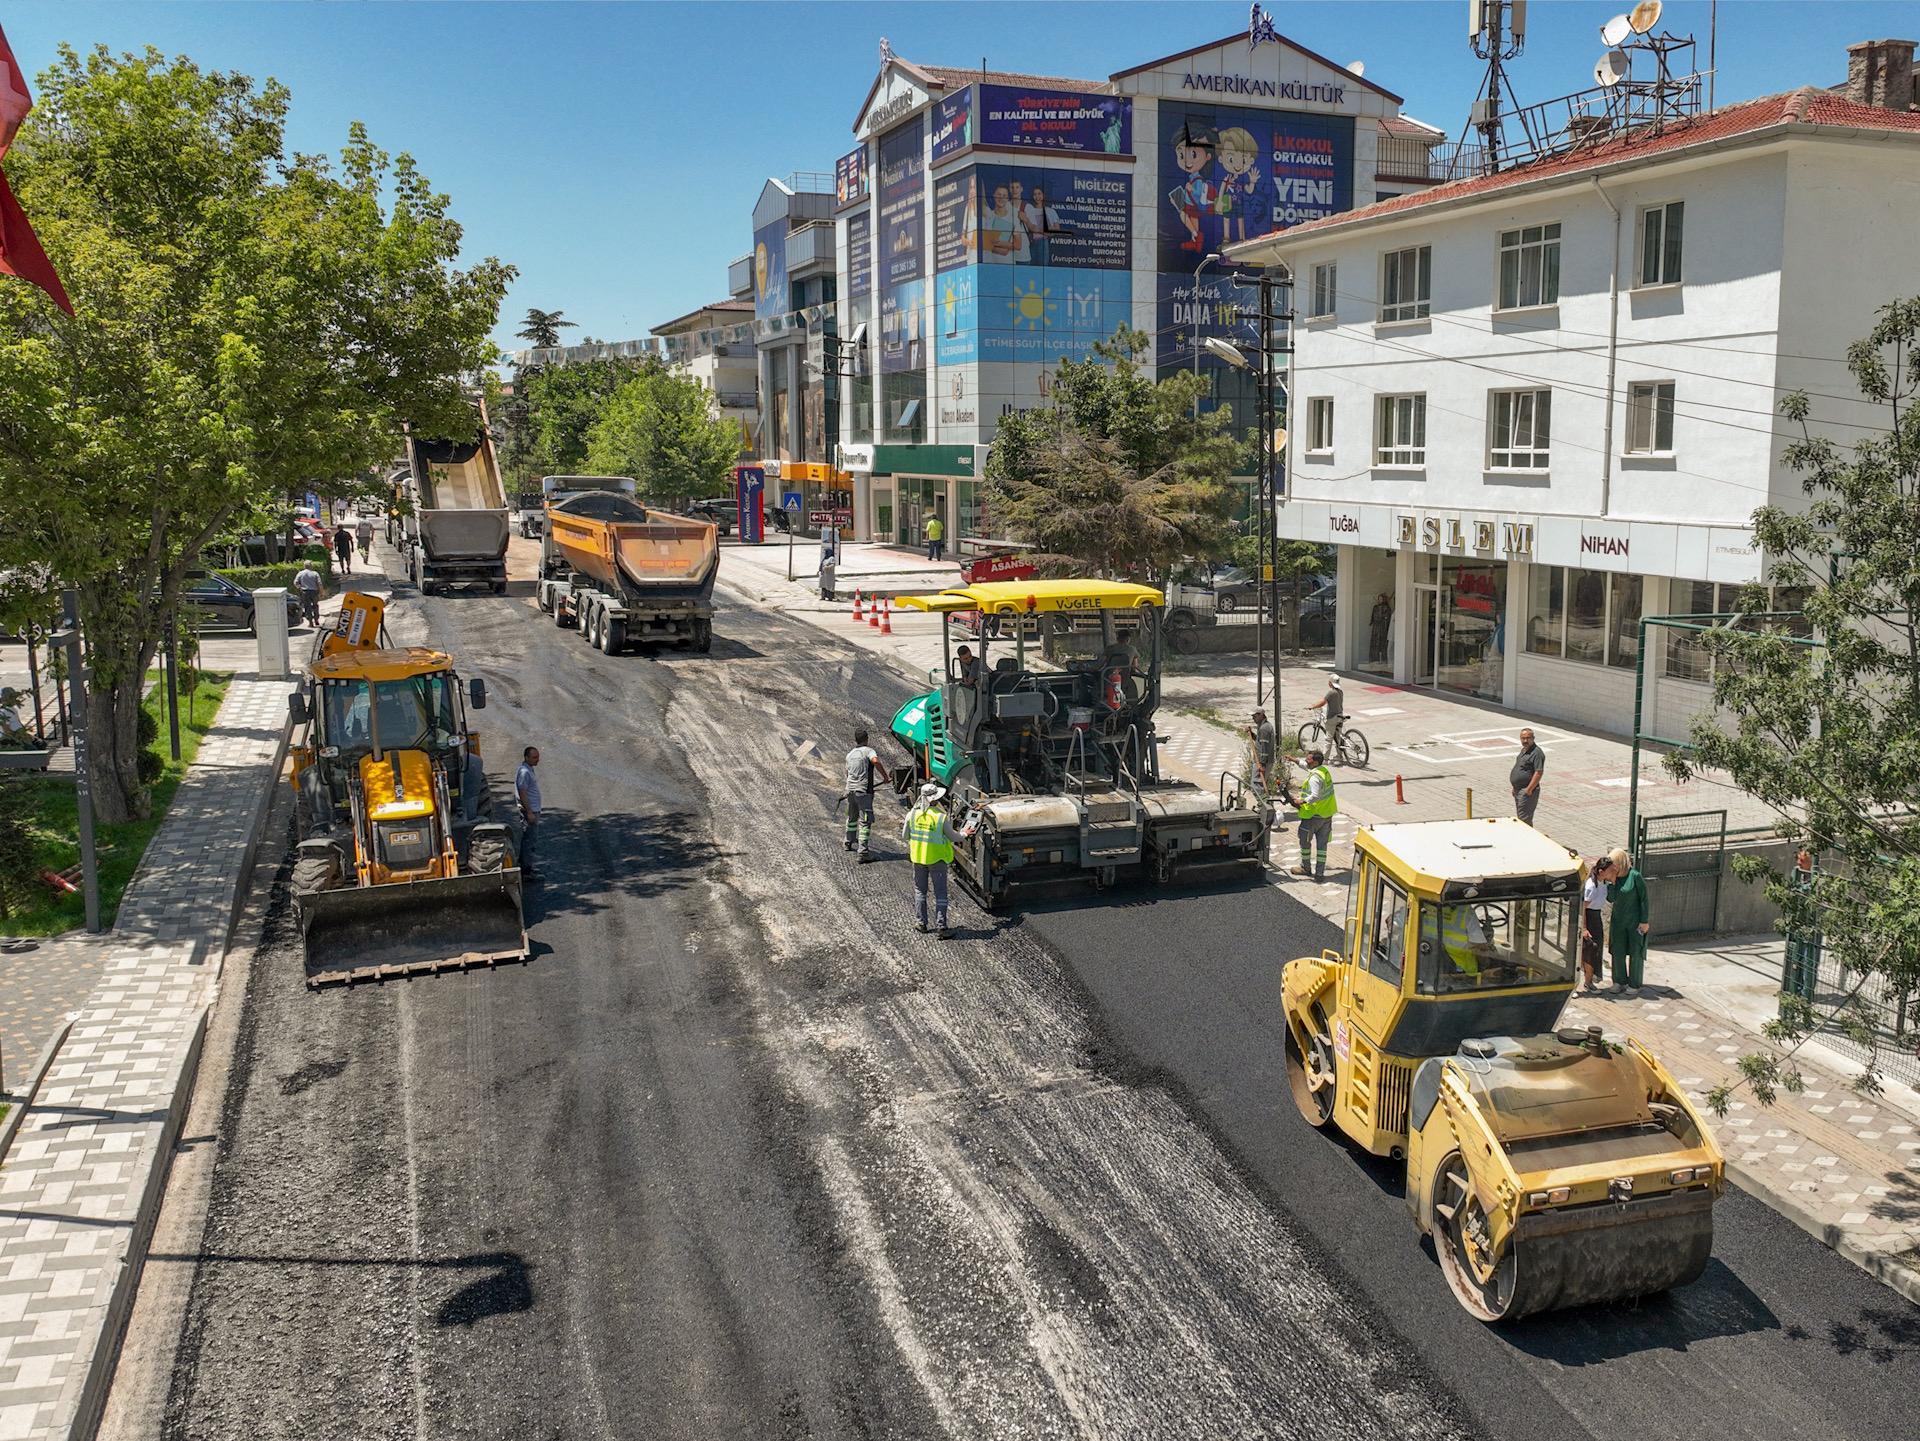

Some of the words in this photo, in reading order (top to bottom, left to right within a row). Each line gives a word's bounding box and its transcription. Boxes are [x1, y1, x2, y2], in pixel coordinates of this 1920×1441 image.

[1183, 73, 1275, 98] AMERİKAN
[1279, 80, 1344, 104] KÜLTÜR
[989, 111, 1002, 119] EN
[1003, 109, 1043, 120] KALİTELİ
[1044, 111, 1057, 119] VE
[1058, 111, 1071, 119] EN
[1073, 108, 1104, 119] BÜYÜK
[1274, 133, 1333, 152] İLKOKUL
[1273, 151, 1334, 166] ORTAOKUL
[1074, 176, 1126, 192] İNGİLİZCE
[1273, 176, 1333, 204] YENİ
[1078, 204, 1108, 213] İNGİLİZCE
[1088, 213, 1126, 223] EĞİTMENLER
[1100, 223, 1126, 232] GEÇERLİ
[1093, 248, 1126, 256] EUROPASS
[1067, 286, 1100, 318] İYİ
[1173, 302, 1211, 325] DAHA
[984, 336, 1042, 349] ETİMESGUT
[1044, 338, 1066, 351] İLÇE
[1330, 514, 1360, 533] TUĞBA
[1397, 515, 1533, 554] ESLEM
[1056, 597, 1102, 609] VÖGELE
[394, 834, 417, 842] JCB
